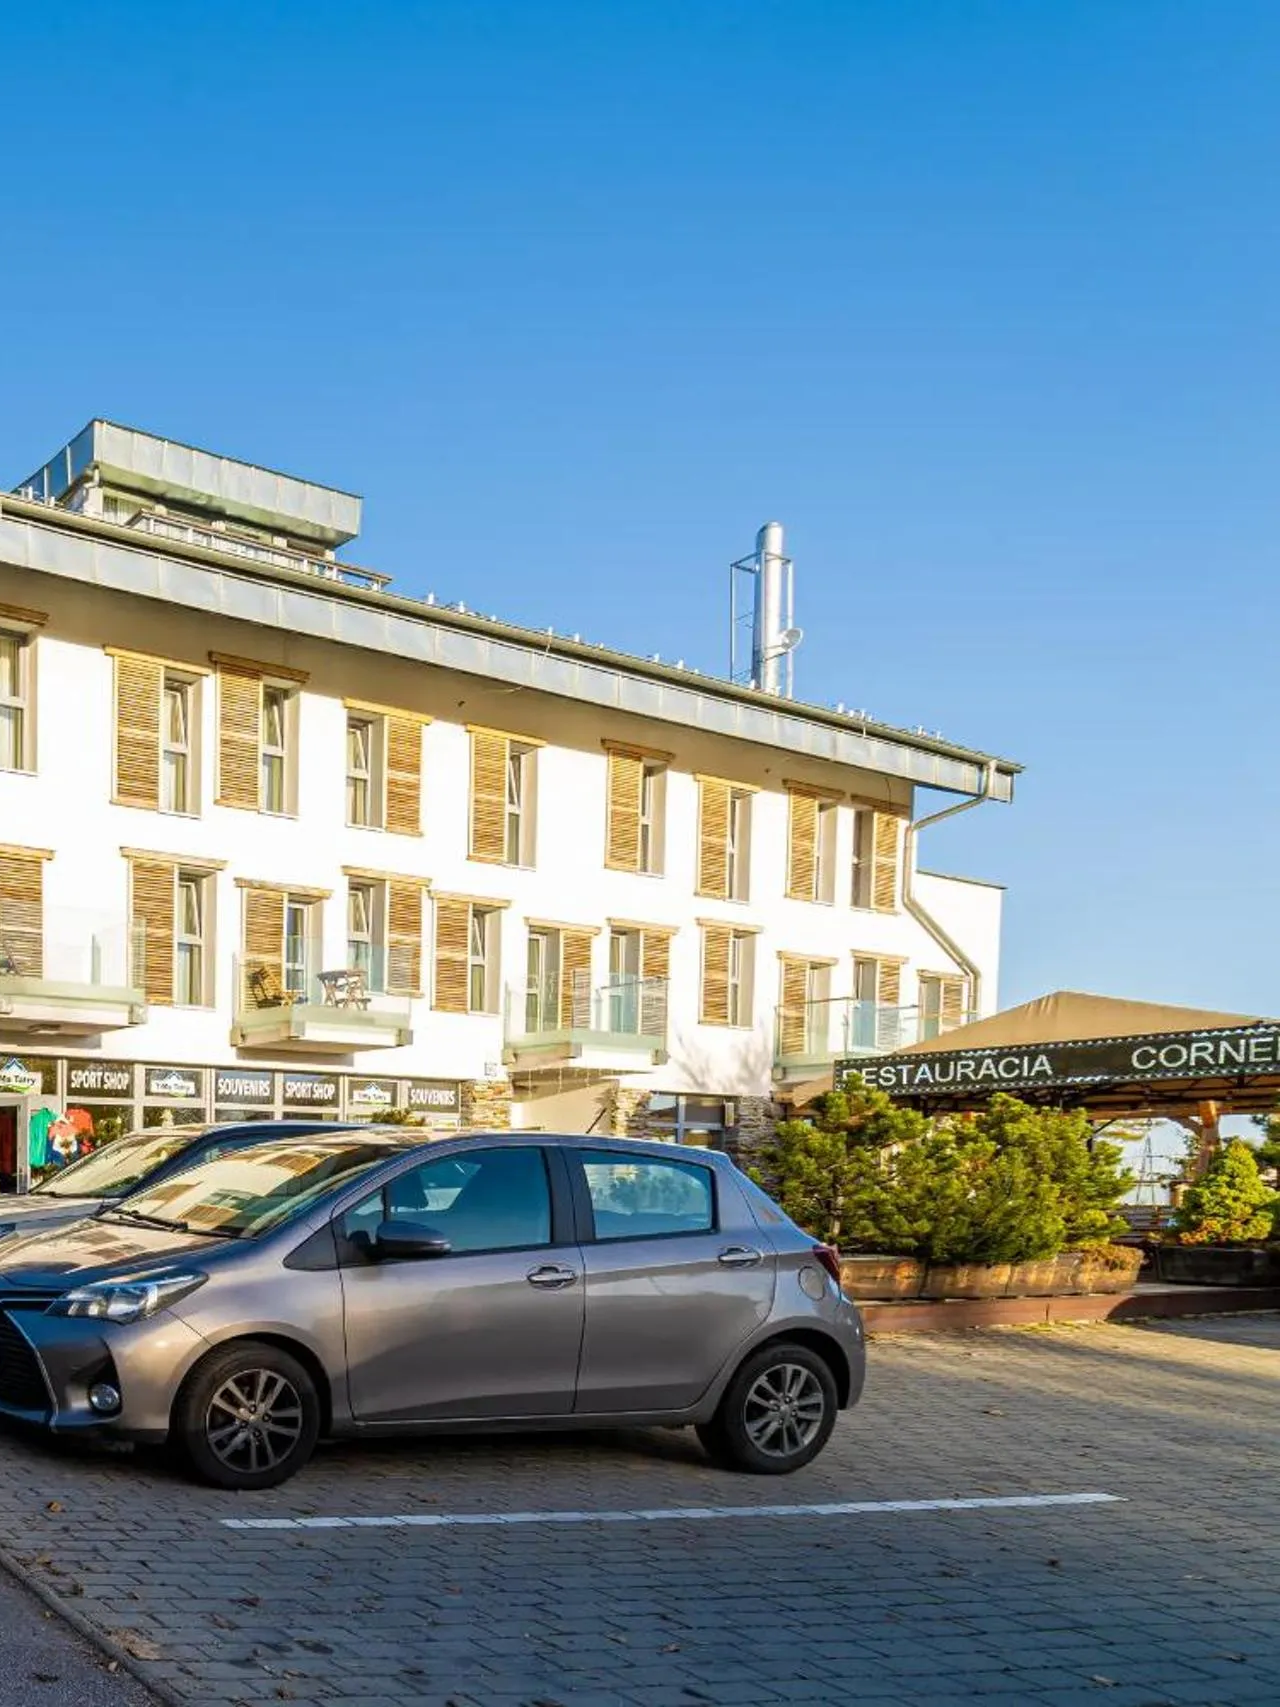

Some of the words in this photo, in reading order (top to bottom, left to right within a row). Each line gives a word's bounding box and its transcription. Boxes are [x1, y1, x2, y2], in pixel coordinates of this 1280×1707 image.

[1131, 1036, 1280, 1070] CORNE
[71, 1069, 102, 1089] SPORT
[103, 1071, 130, 1090] SHOP
[217, 1078, 270, 1097] SOUVENIRS
[285, 1080, 313, 1099] SPORT
[313, 1083, 336, 1101] SHOP
[410, 1088, 456, 1106] SOUVENIRS
